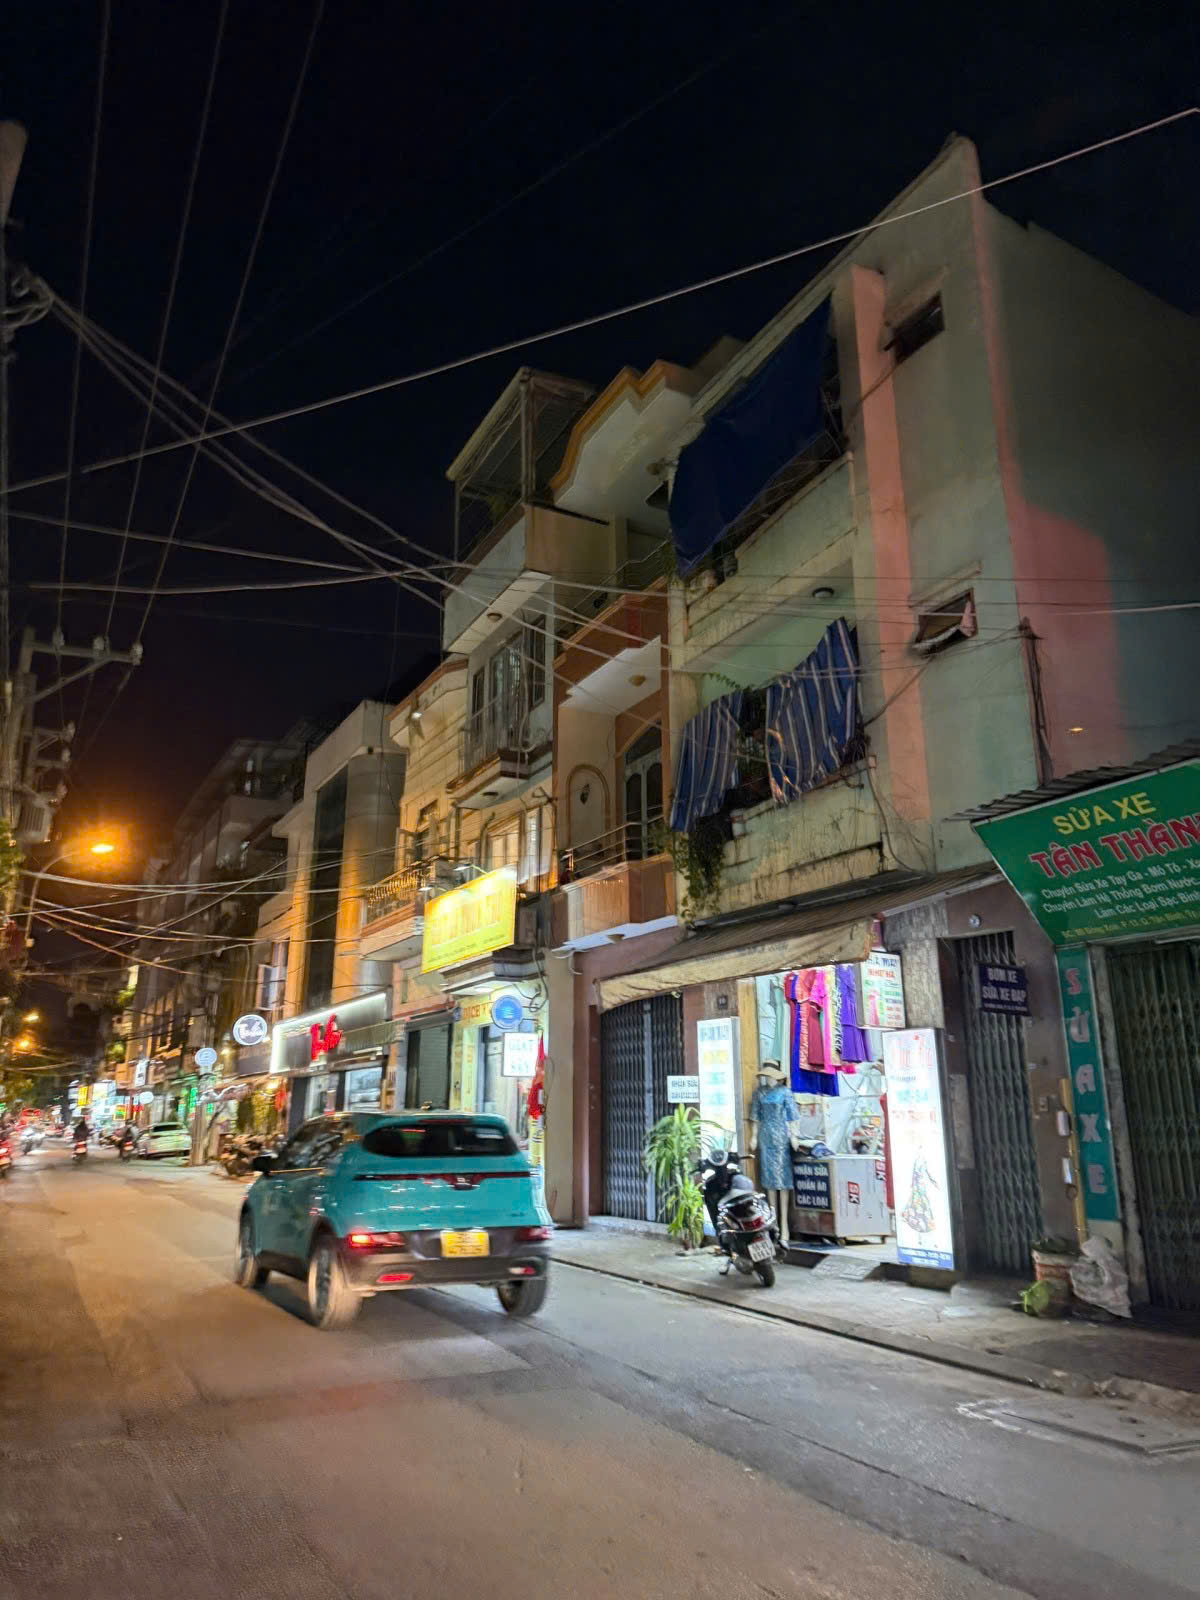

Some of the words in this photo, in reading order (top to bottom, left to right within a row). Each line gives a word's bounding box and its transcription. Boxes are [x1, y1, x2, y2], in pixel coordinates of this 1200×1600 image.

[1053, 805, 1115, 835] SỬA
[1112, 792, 1157, 819] XE
[1028, 841, 1104, 879] TÂN
[1099, 812, 1200, 863] THÀN
[1094, 877, 1109, 889] Xe
[1107, 874, 1127, 886] Tay
[1007, 970, 1018, 983] XE
[999, 987, 1010, 1001] XE
